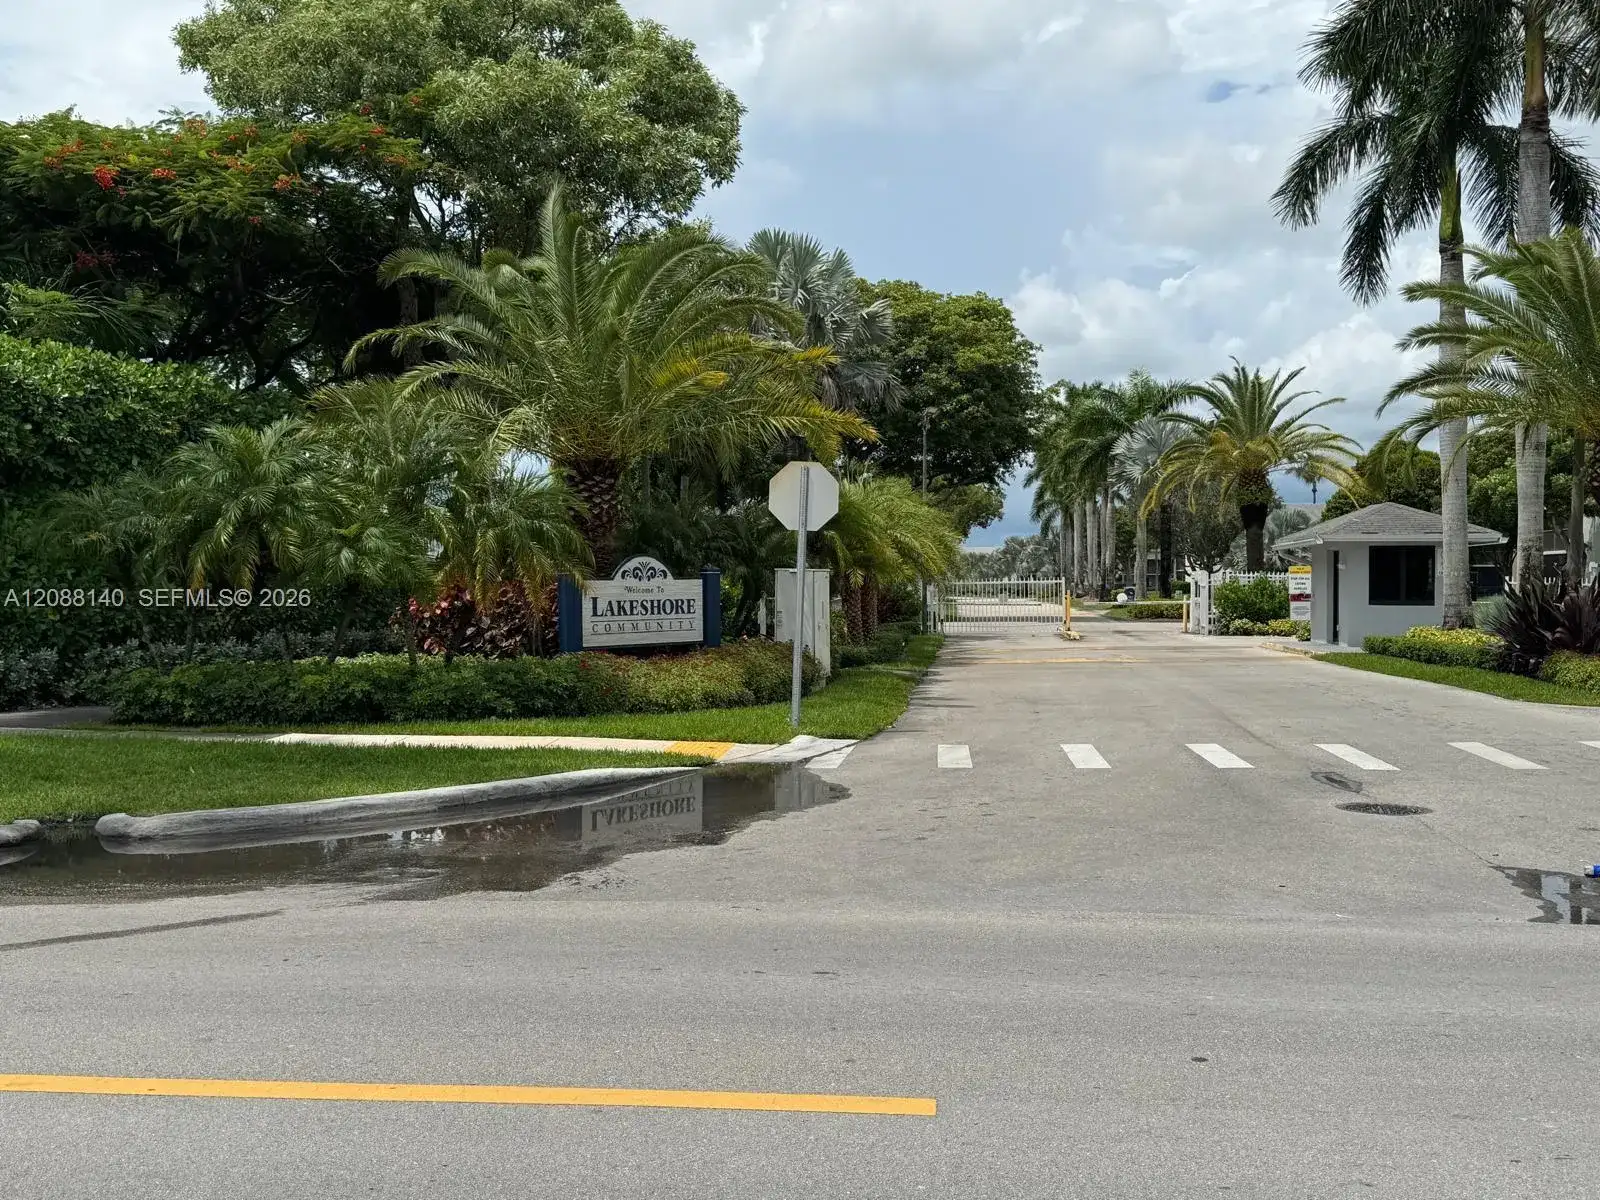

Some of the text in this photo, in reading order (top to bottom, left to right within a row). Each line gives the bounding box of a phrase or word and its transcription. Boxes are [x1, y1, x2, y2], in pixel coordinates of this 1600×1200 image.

[624, 586, 654, 594] Welcome
[590, 596, 696, 617] LAKESHORE
[592, 620, 695, 633] COMMUNITY
